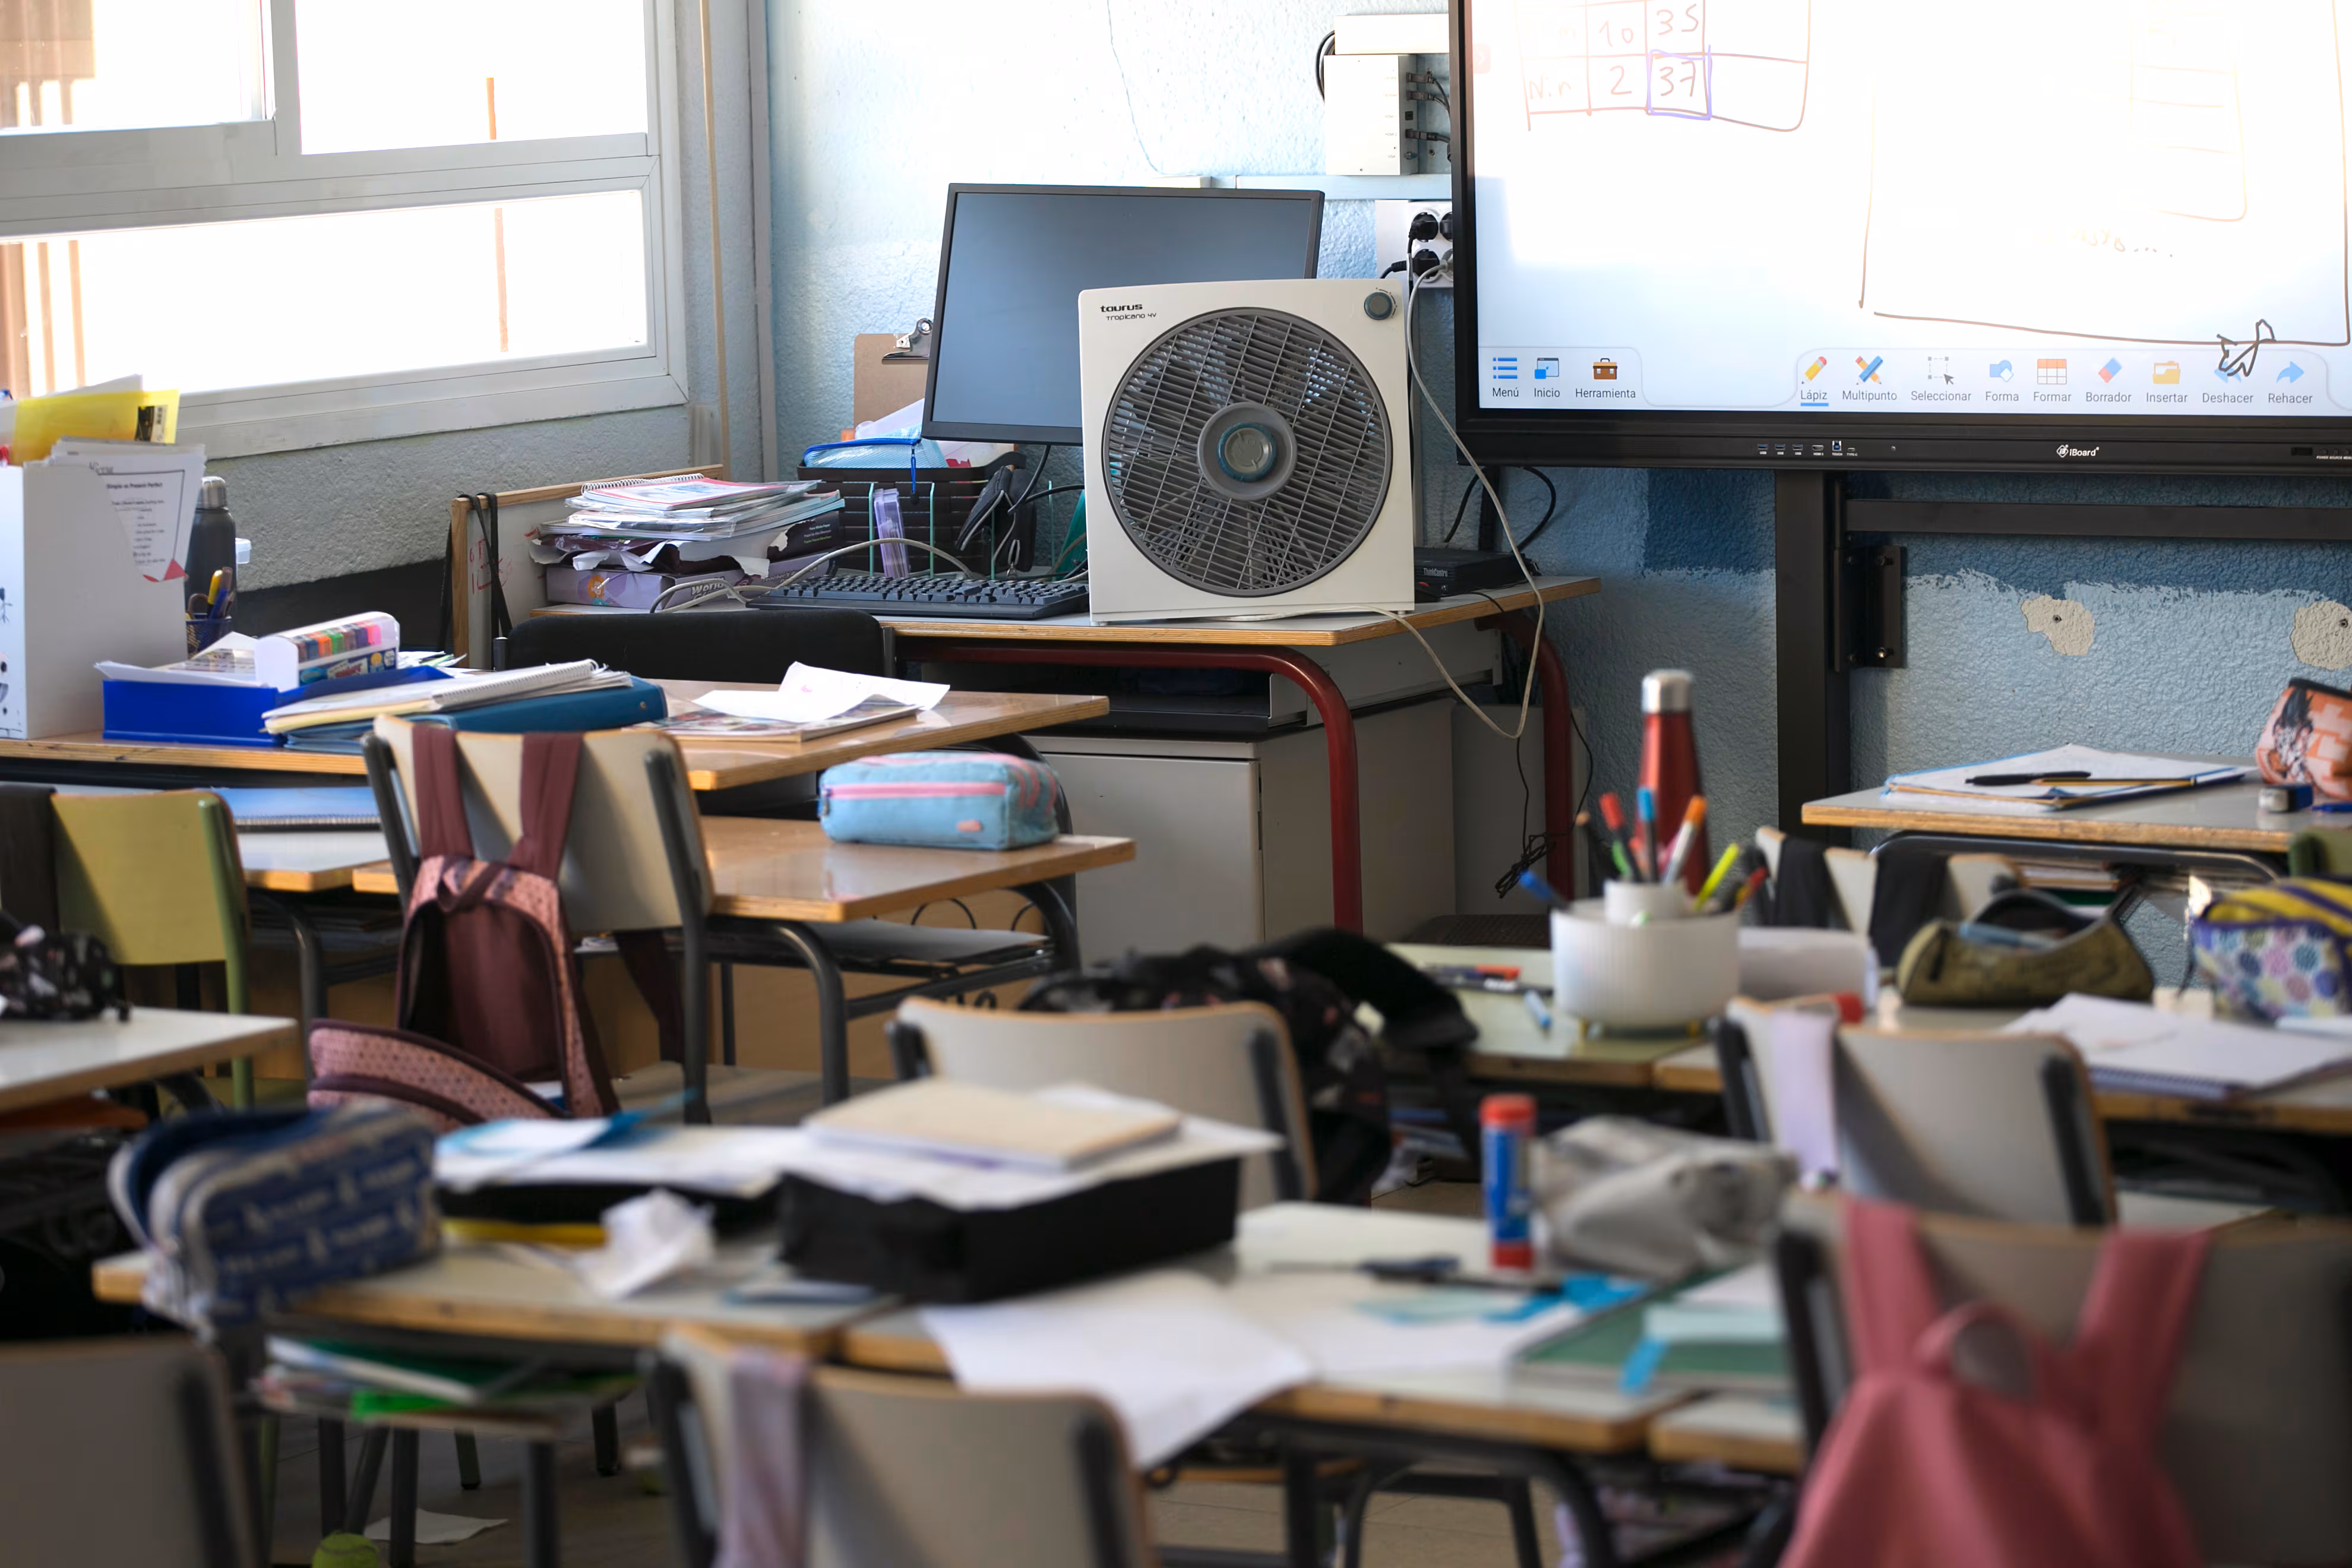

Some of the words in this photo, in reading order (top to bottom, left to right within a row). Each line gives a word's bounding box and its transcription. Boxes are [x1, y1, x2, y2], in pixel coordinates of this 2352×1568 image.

[1598, 19, 1635, 48] 10
[1656, 3, 1700, 36] 35
[1609, 65, 1633, 95] 2
[1656, 60, 1697, 97] 37
[1100, 304, 1143, 312] taurus
[1493, 387, 1519, 397] Menú
[1534, 388, 1560, 397] Inicio
[1575, 388, 1636, 398] Herramienta
[1801, 390, 1828, 402] Lápiz
[1842, 390, 1897, 402] Multipunto
[1911, 390, 1972, 401] Seleccionar
[1986, 391, 2019, 402] Forma
[2034, 391, 2072, 402] Formar
[2086, 391, 2132, 402] Borrador
[2146, 392, 2188, 403] Insertar
[2202, 392, 2253, 403] Deshacer
[2268, 393, 2313, 403] Rehacer
[2069, 448, 2097, 457] iBoard
